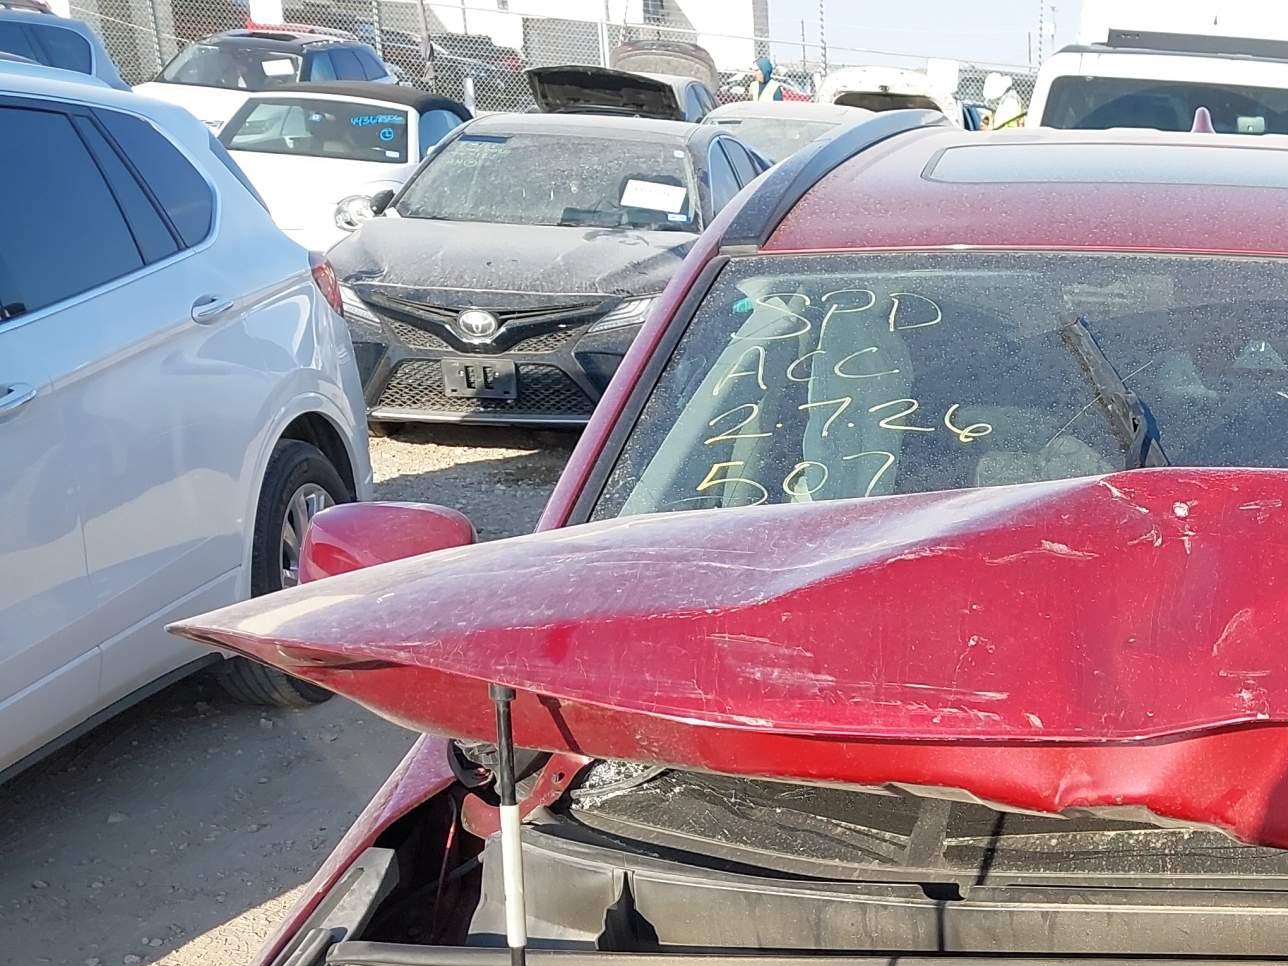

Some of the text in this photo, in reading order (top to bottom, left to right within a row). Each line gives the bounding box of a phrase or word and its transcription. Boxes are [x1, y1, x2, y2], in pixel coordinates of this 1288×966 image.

[730, 289, 942, 349] SPD
[712, 346, 900, 395] ACC
[704, 397, 993, 445] 2.7.26
[672, 451, 895, 506] 507
